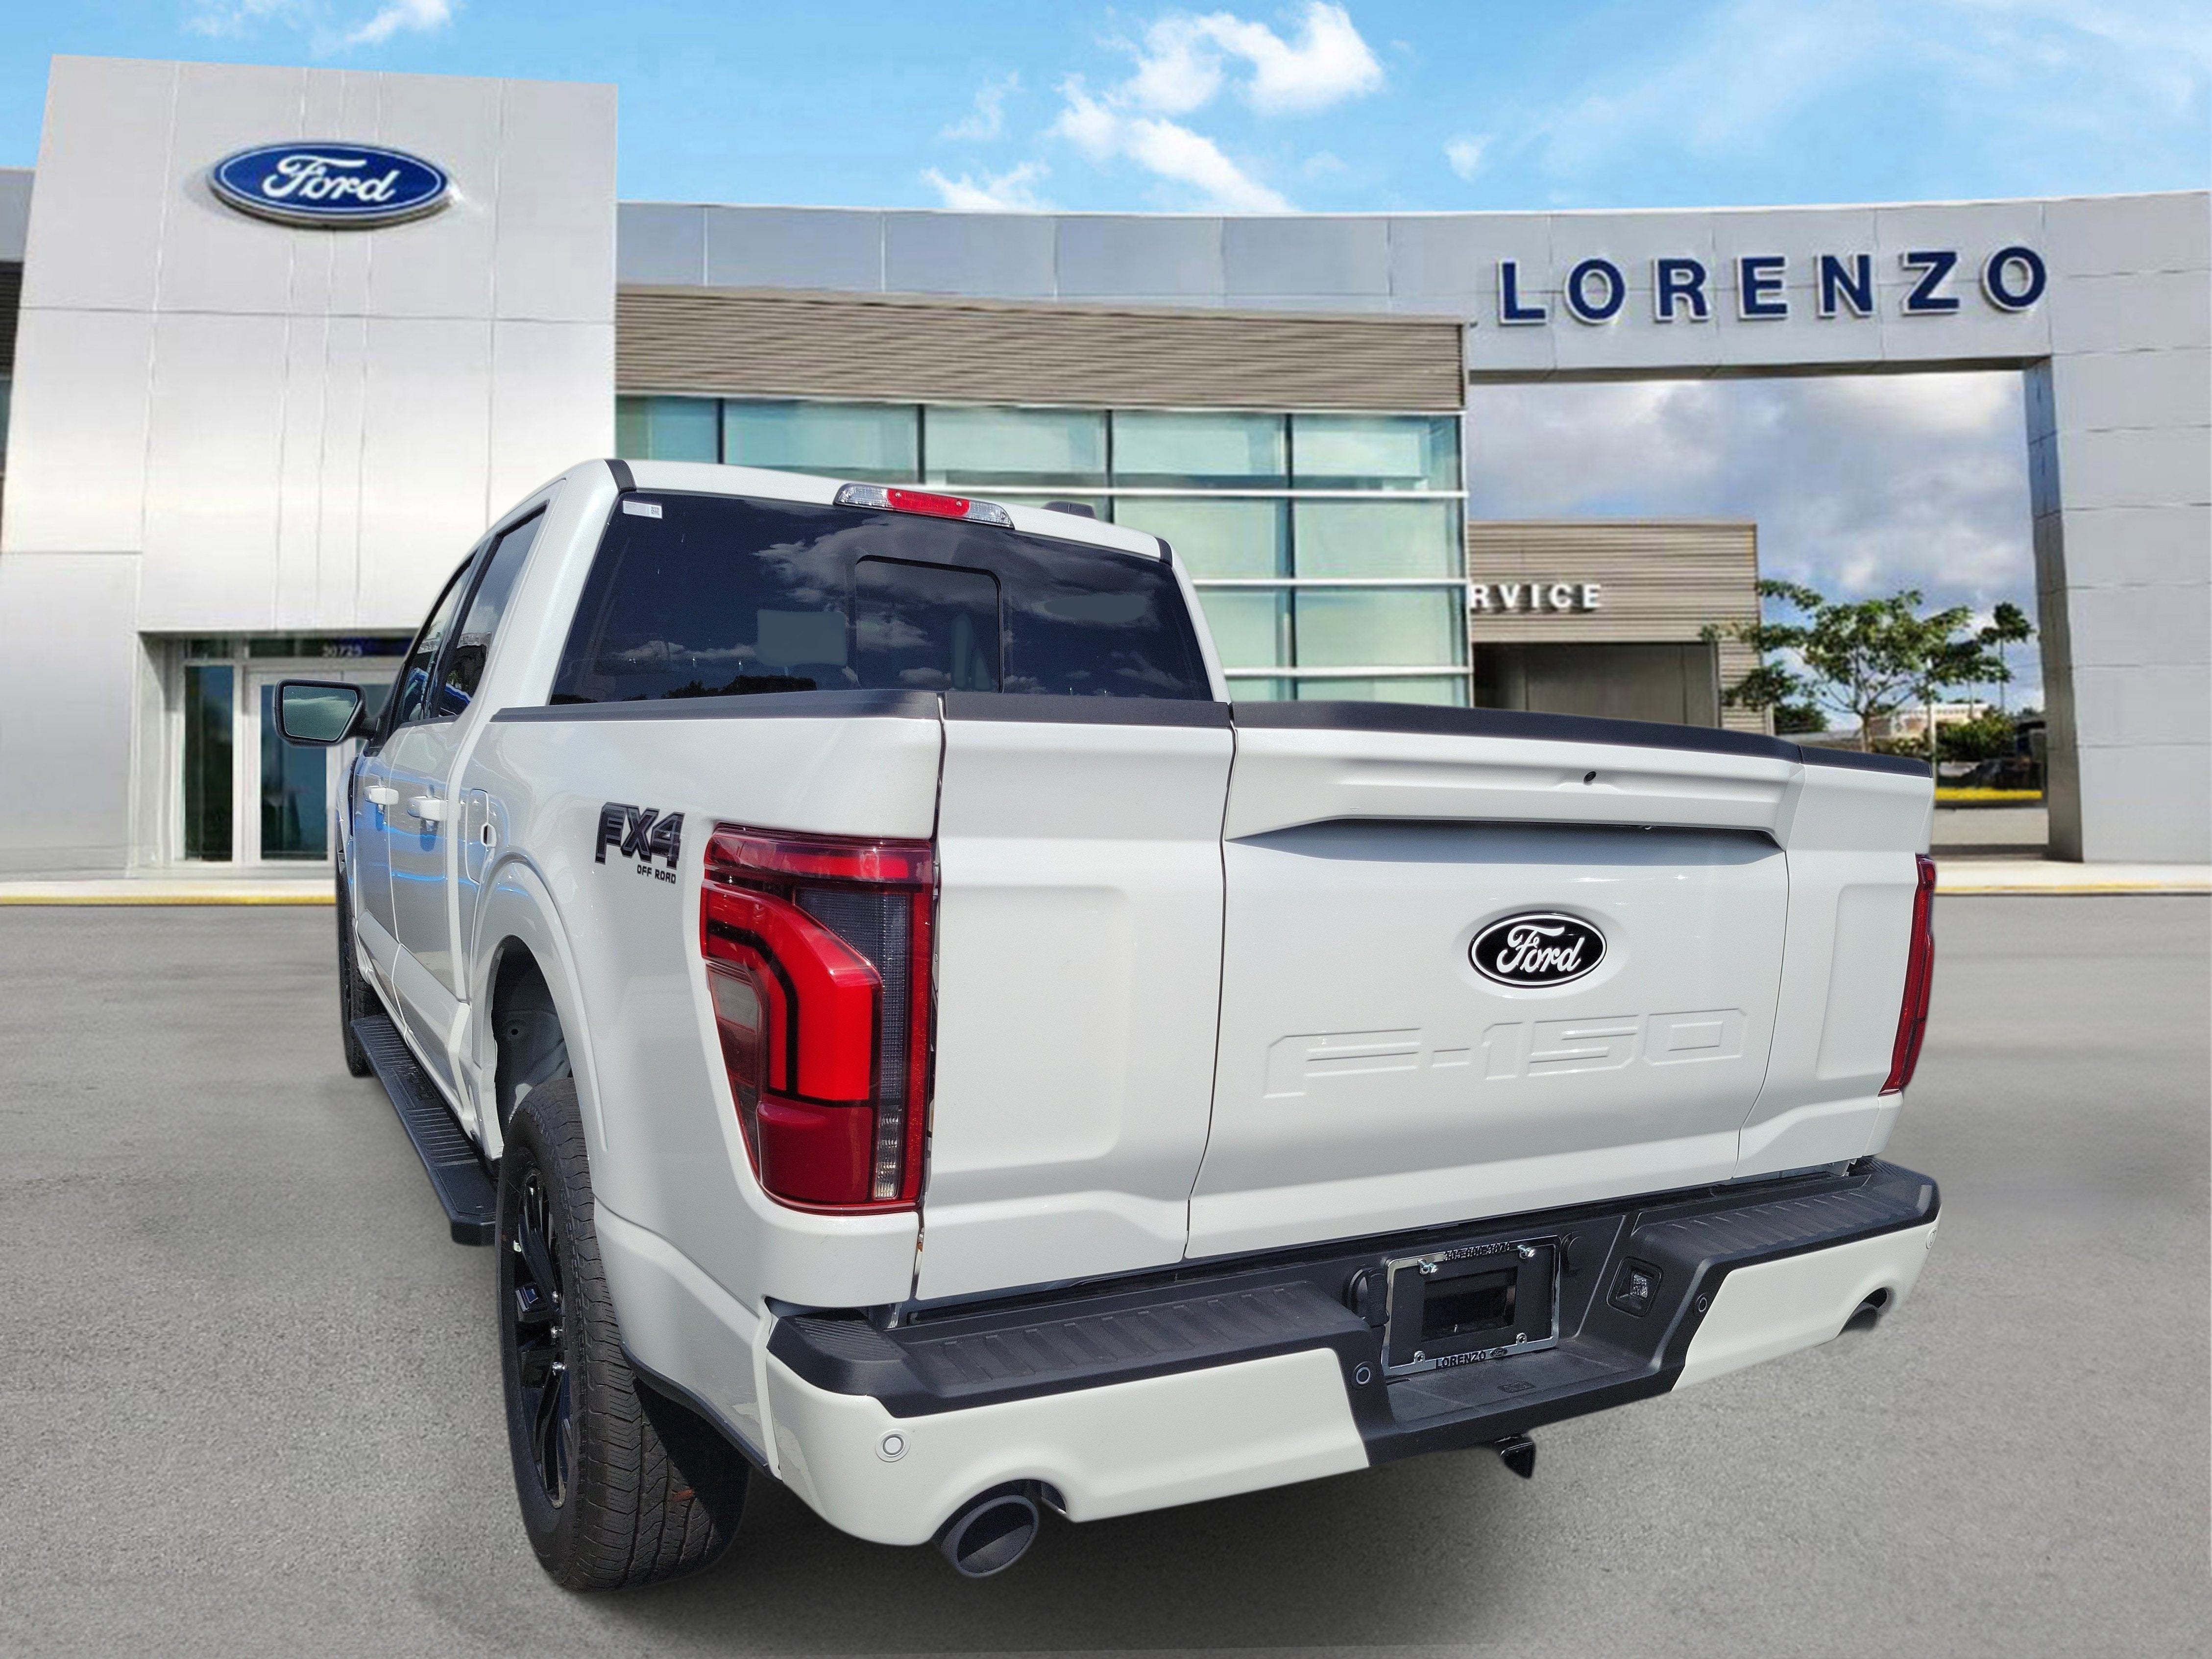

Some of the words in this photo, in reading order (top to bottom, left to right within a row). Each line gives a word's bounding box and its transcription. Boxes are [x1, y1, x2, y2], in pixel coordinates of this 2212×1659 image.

[263, 154, 400, 201] Ford
[1498, 245, 2049, 324] LORENZO
[595, 802, 685, 870] FX4
[637, 864, 652, 877] OFF
[655, 868, 676, 884] ROAD
[1496, 924, 1585, 974] Ford
[1263, 1007, 1749, 1099] F-150
[1435, 1350, 1486, 1369] LORENZO
